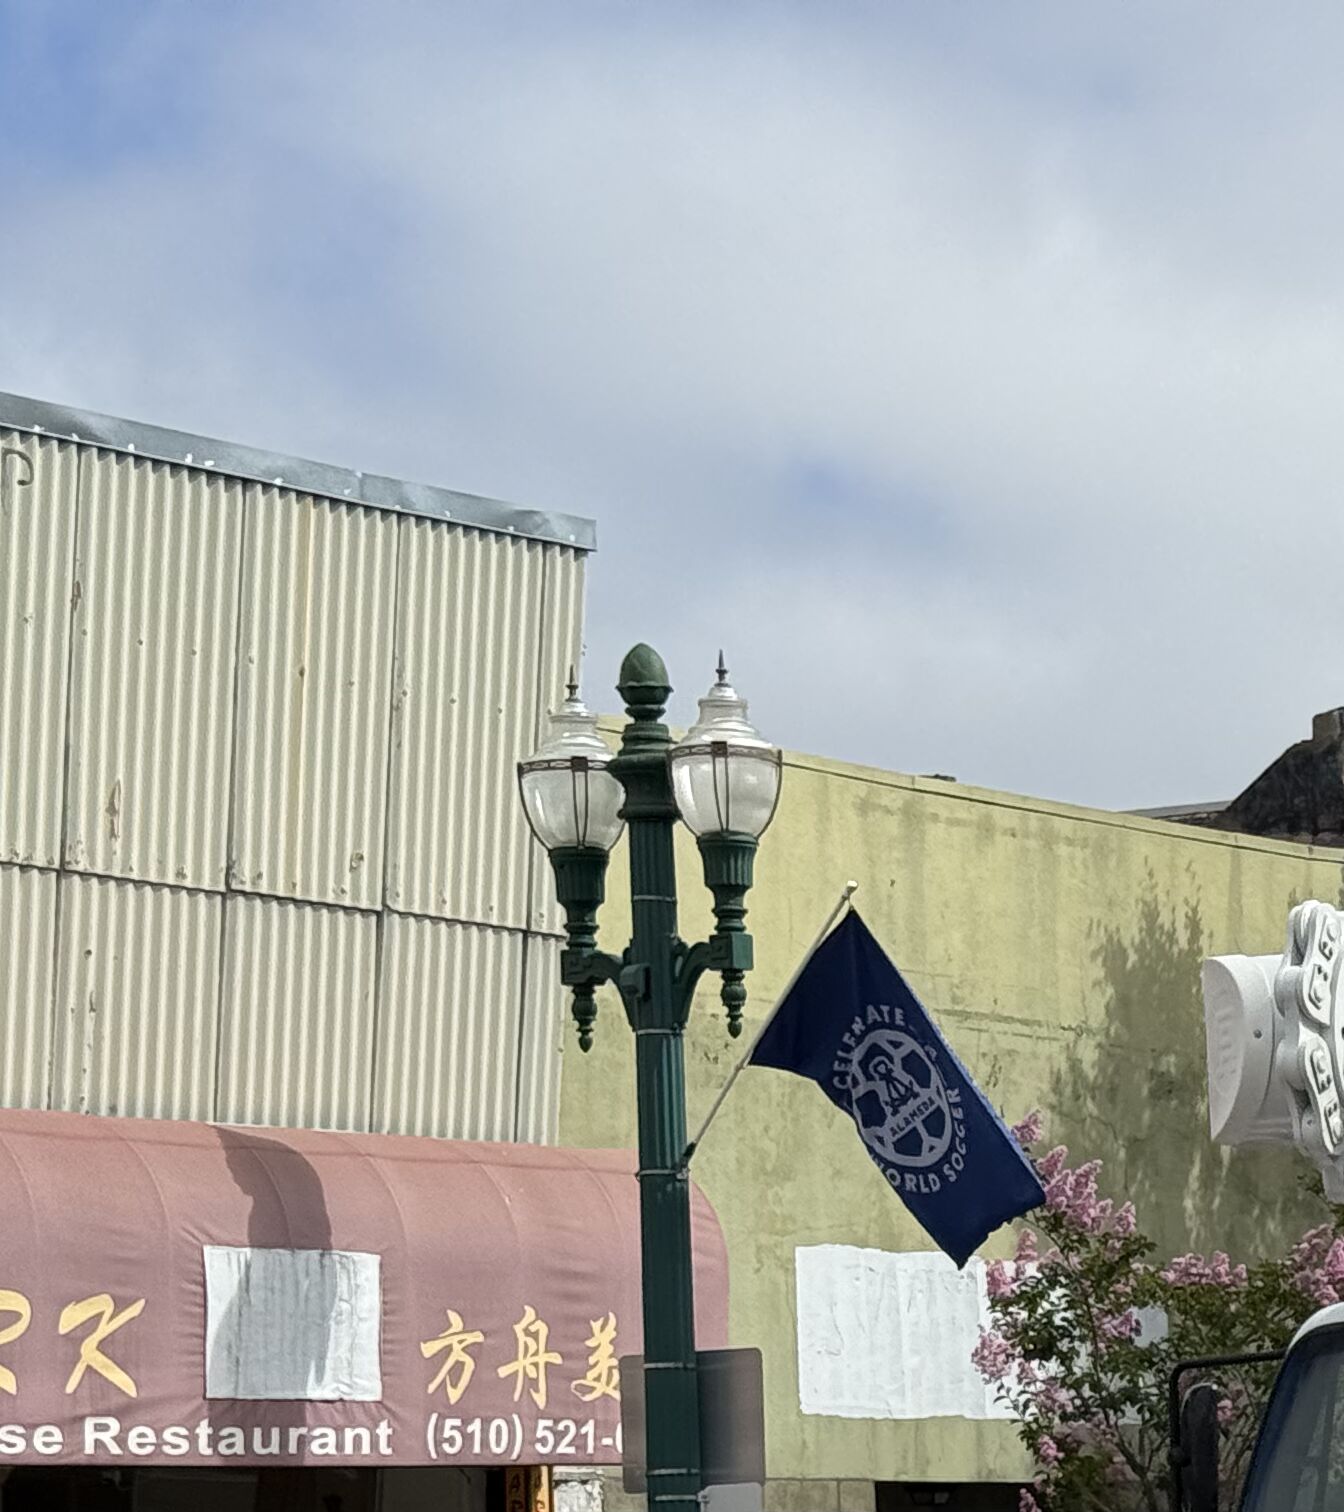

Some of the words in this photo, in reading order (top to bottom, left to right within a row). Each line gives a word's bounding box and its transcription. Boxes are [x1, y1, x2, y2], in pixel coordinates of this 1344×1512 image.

[889, 1096, 936, 1138] ALAMEDA
[942, 1087, 967, 1183] SOCCER
[83, 1415, 393, 1456] Restaurant
[427, 1412, 523, 1460] (510)
